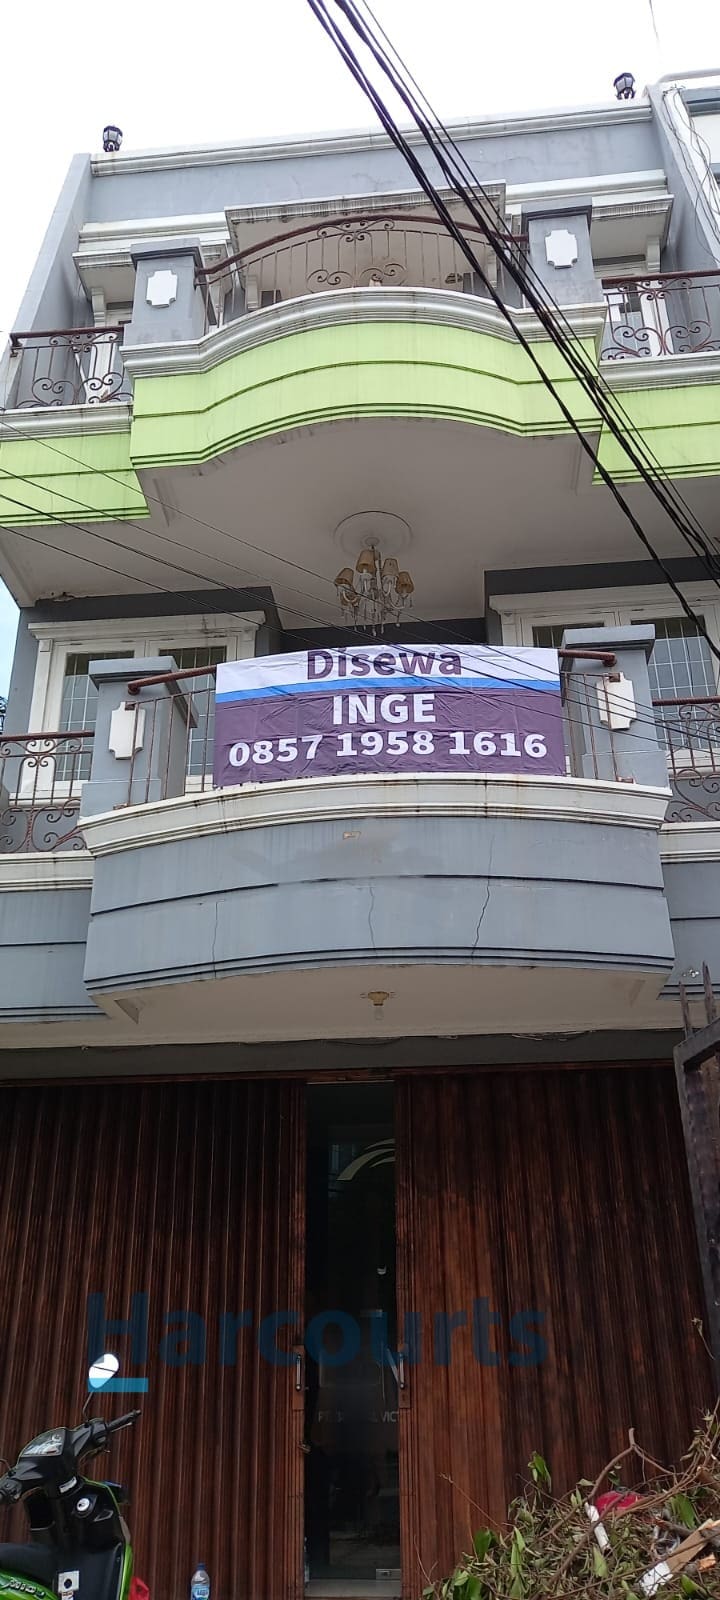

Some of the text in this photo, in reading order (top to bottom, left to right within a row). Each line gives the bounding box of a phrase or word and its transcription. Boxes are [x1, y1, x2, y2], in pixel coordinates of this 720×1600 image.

[306, 649, 462, 680] Disewa
[333, 693, 436, 725] INGE
[228, 731, 548, 767] 0857 1958 1616
